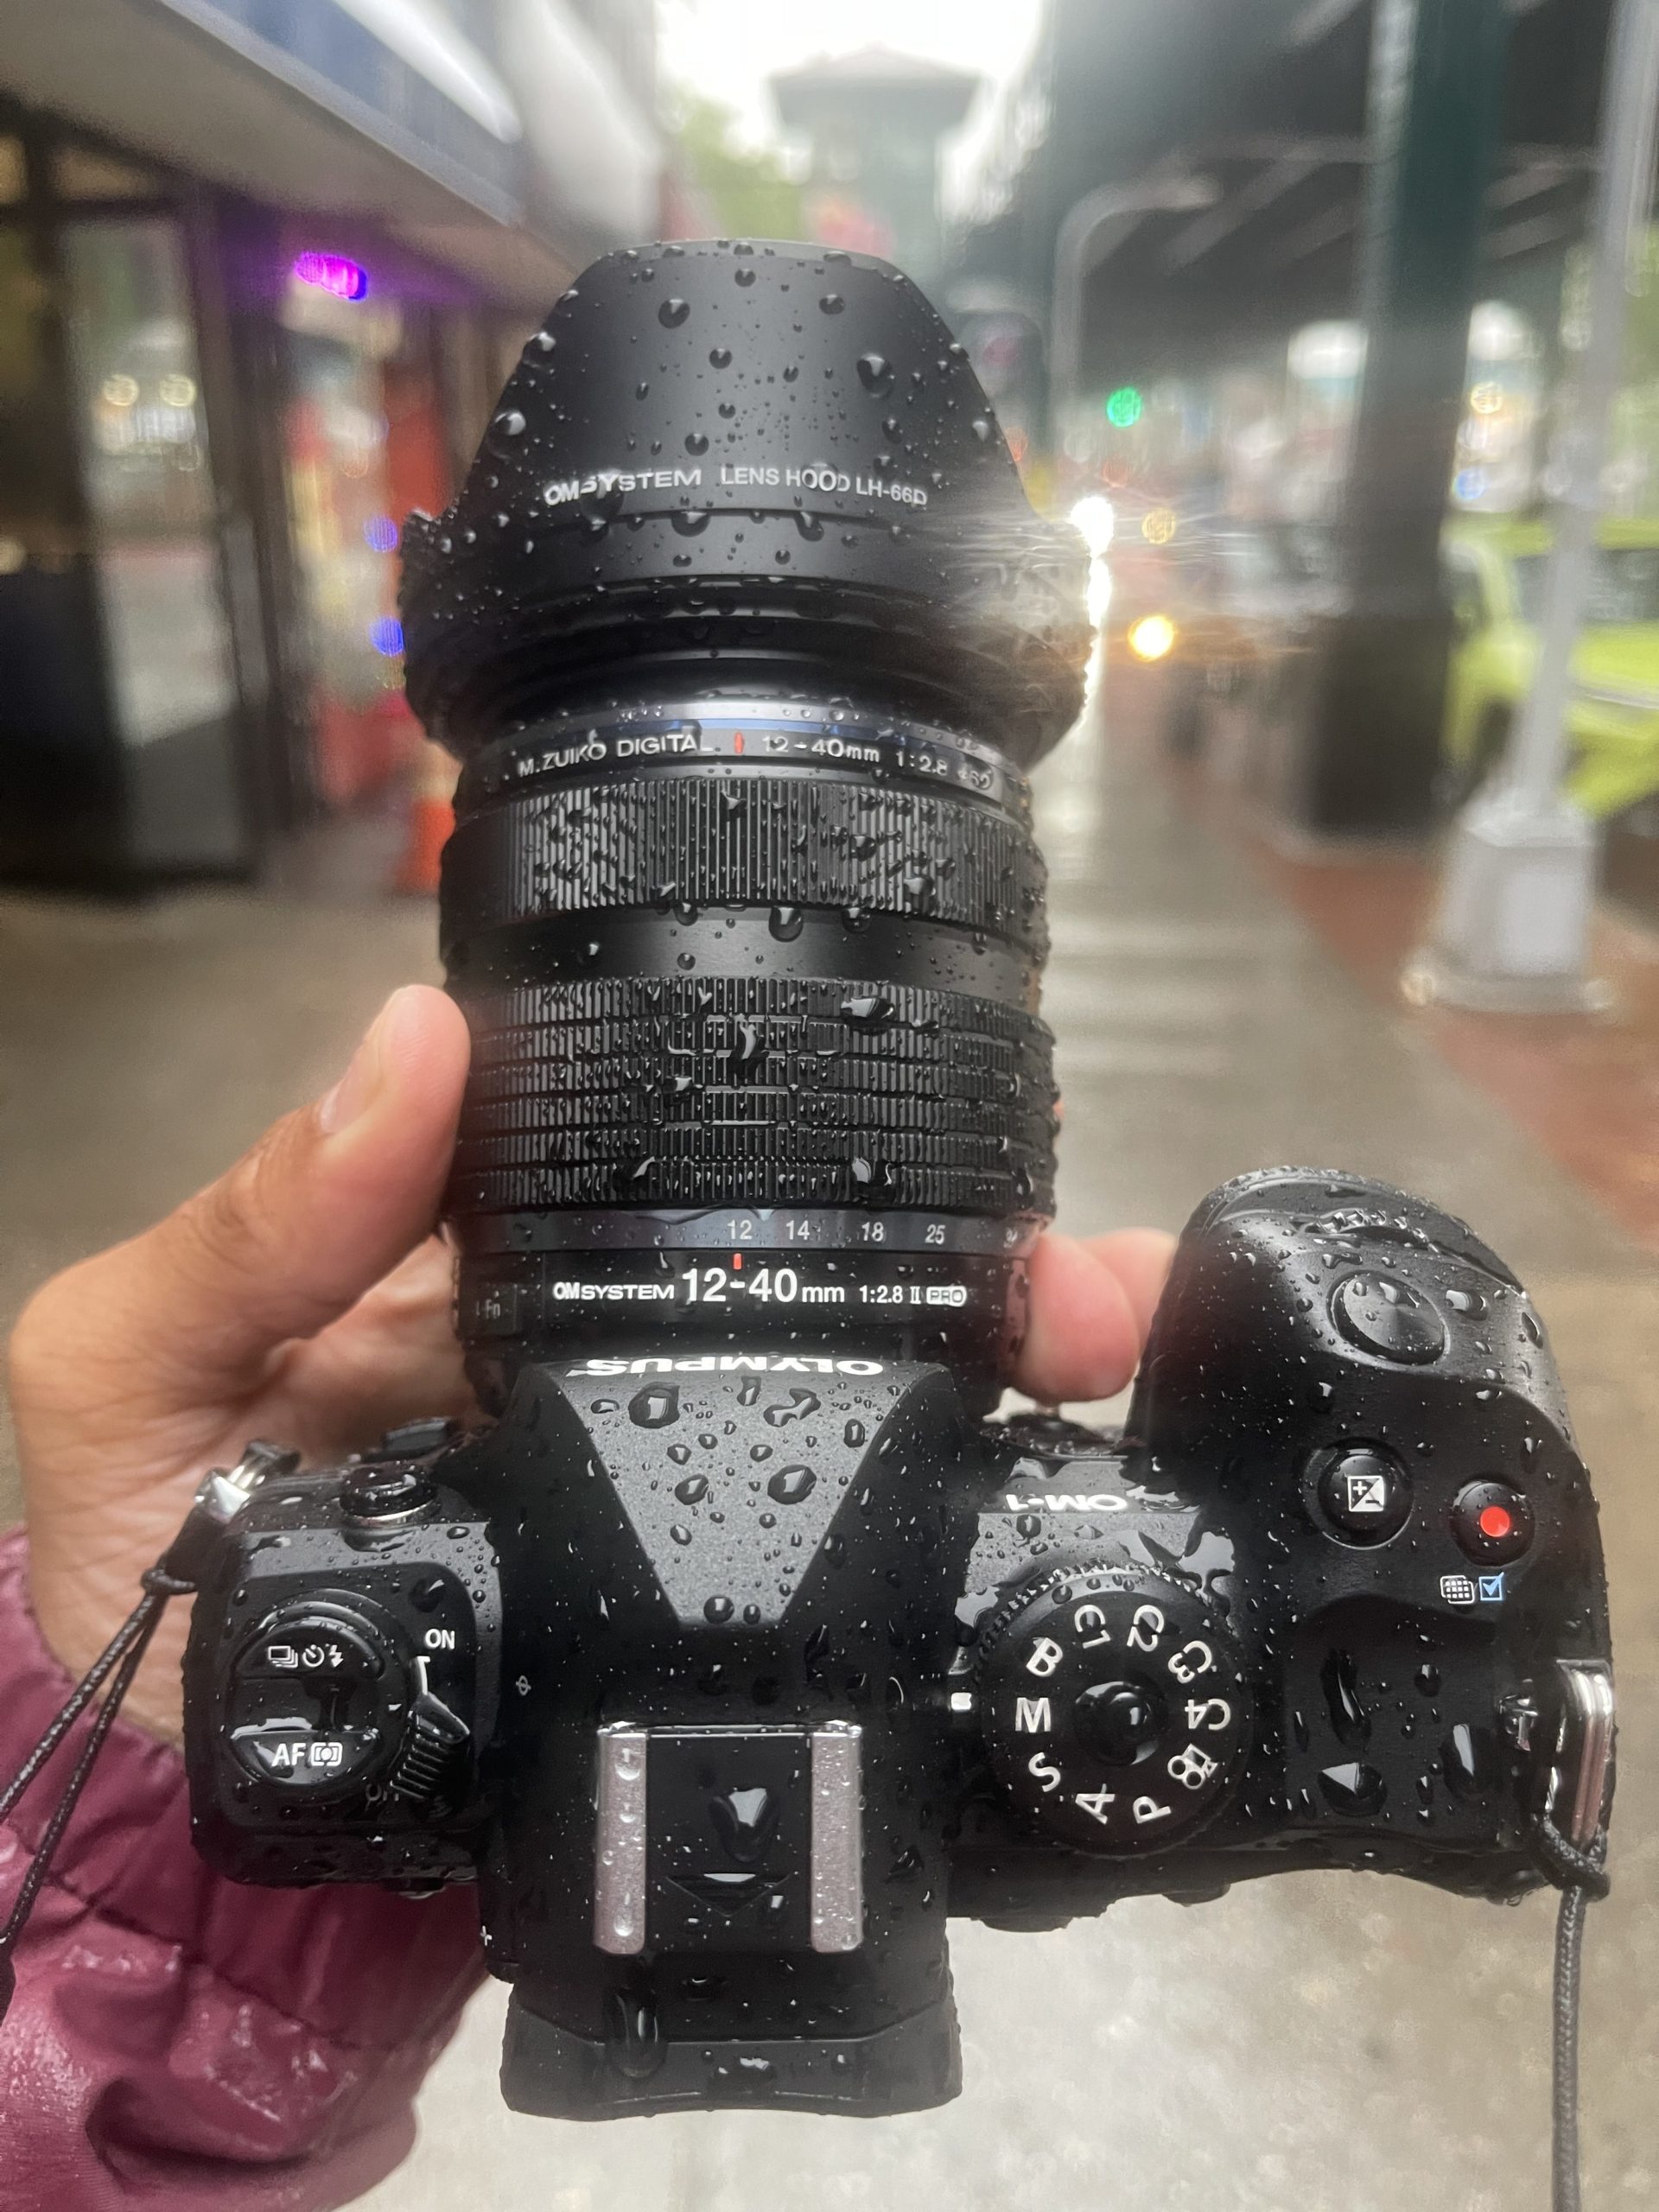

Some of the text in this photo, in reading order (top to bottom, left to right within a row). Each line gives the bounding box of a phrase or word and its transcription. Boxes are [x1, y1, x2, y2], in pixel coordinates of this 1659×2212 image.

[721, 467, 780, 486] LENS
[785, 468, 851, 492] HOOD
[855, 476, 927, 505] LH-66D
[895, 749, 949, 776] 1:2.8
[727, 1219, 946, 1245] 12 14 18 25
[859, 1284, 904, 1305] 1:2.8
[928, 1287, 965, 1306] PRO
[586, 1356, 884, 1376] OLYMPUS
[1005, 1493, 1128, 1512] OM-1
[424, 1628, 456, 1649] ON
[1074, 1605, 1111, 1649] C1
[1127, 1605, 1165, 1652] C2
[1025, 1637, 1064, 1677] B
[1167, 1640, 1213, 1684] C3
[1014, 1696, 1052, 1733] M
[1184, 1698, 1231, 1731] C4
[271, 1742, 307, 1767] AF
[1027, 1751, 1062, 1792] S
[1075, 1783, 1116, 1825] A
[1132, 1795, 1172, 1825] P
